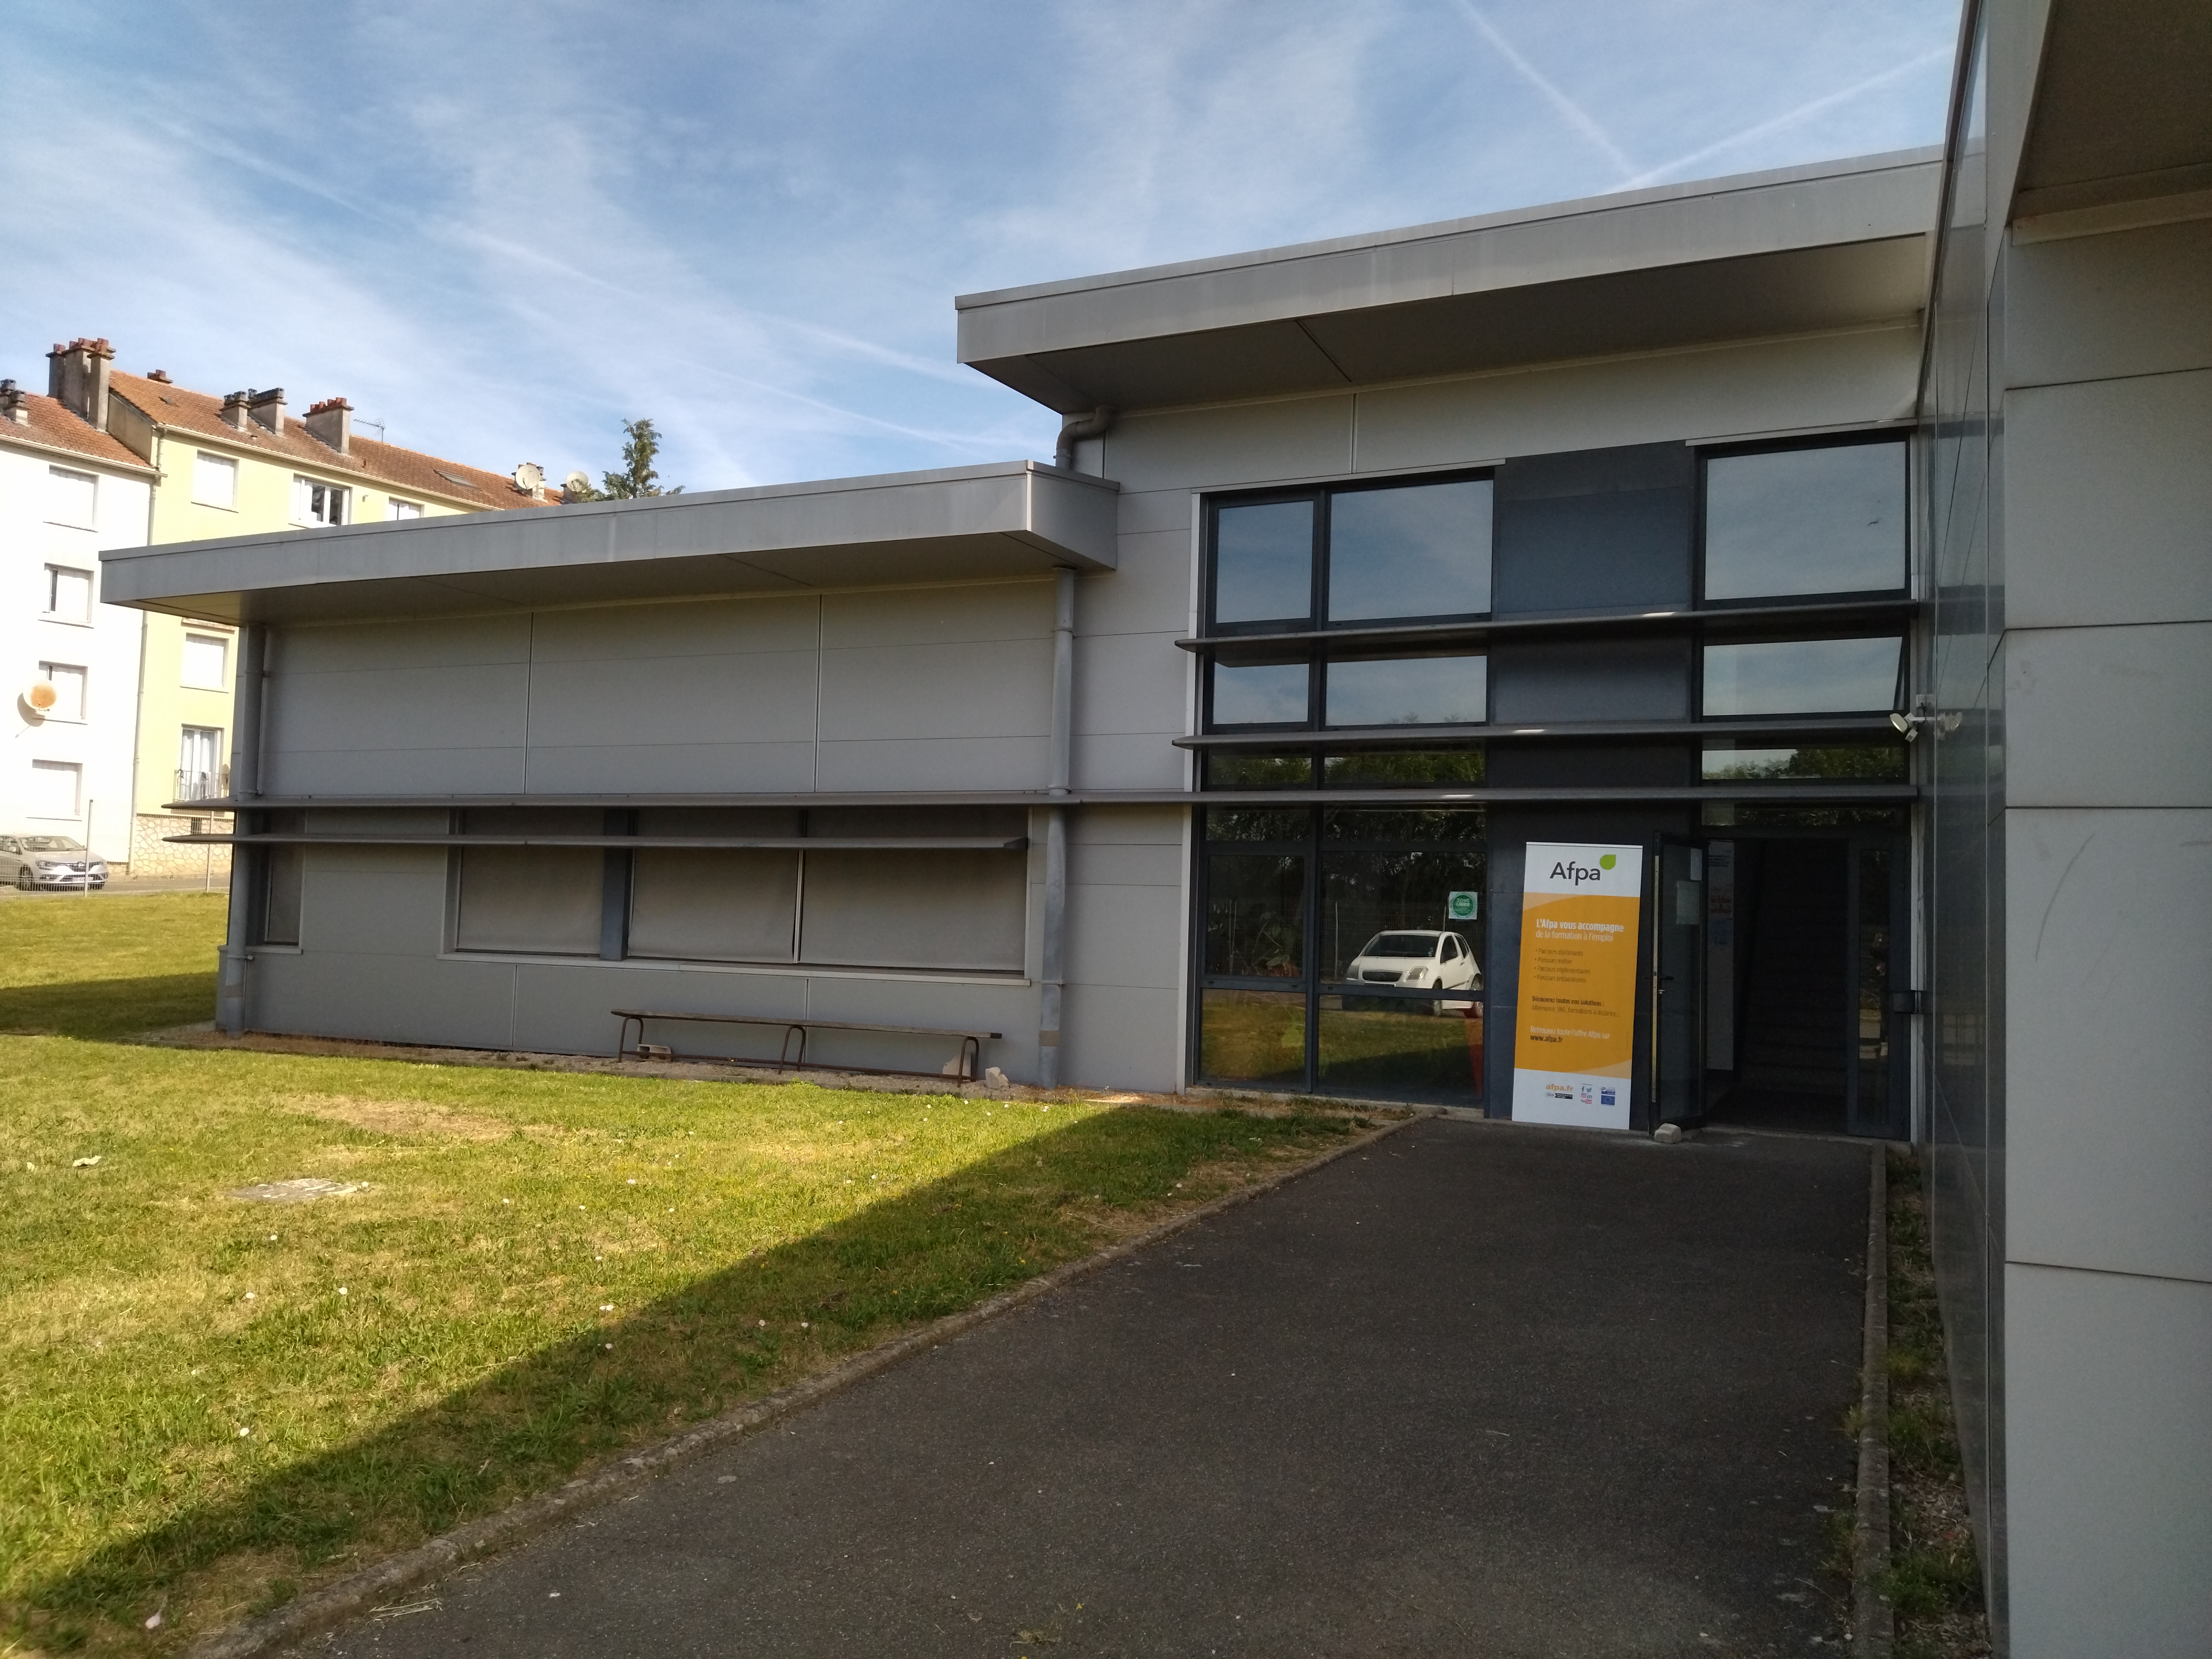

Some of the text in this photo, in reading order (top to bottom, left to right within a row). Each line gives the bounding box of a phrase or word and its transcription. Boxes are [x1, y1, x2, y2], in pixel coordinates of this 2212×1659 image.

[1550, 861, 1601, 886] Afpa
[1536, 919, 1624, 933] L’Afpa vous accompagne
[1536, 930, 1543, 938] de
[1552, 931, 1582, 940] formation
[1589, 933, 1614, 942] l’emploi
[1530, 1026, 1556, 1035] Retrouvez
[1588, 1030, 1601, 1039] Afpa
[1530, 1035, 1563, 1043] www.afpa.fr
